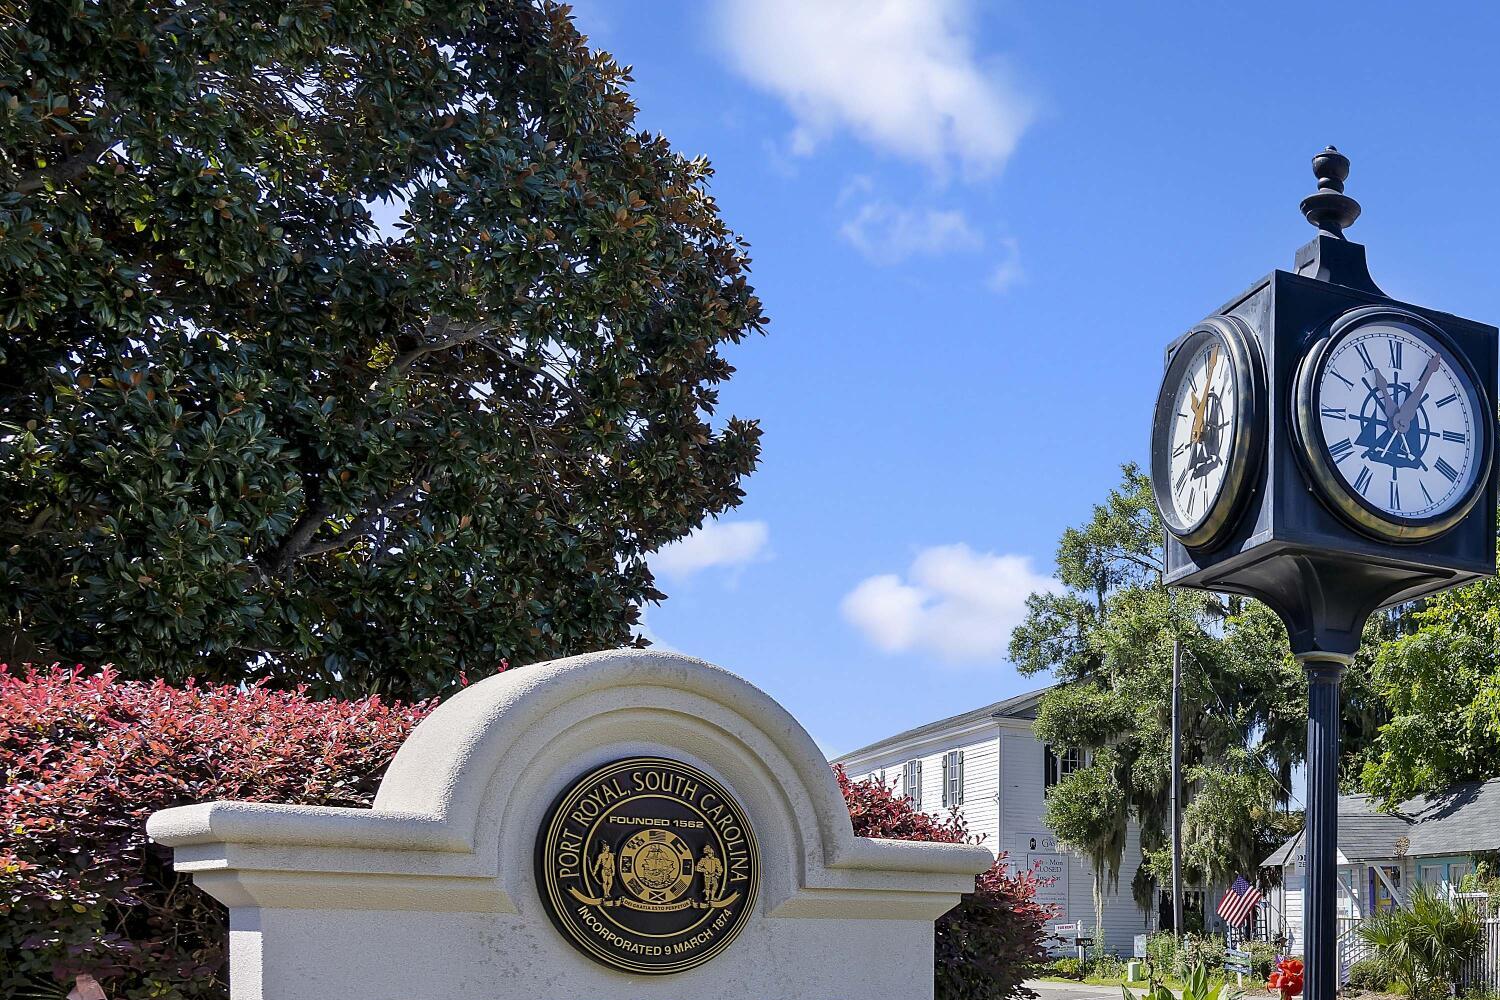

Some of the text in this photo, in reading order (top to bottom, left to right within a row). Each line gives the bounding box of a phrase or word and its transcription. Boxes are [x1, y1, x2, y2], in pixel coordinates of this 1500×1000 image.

[559, 771, 750, 883] PORT ROYAL, SOUTH CAROLINA
[609, 815, 705, 829] FOUNDED 1562
[576, 904, 734, 957] INCORPORATED 9 MARCH 1874
